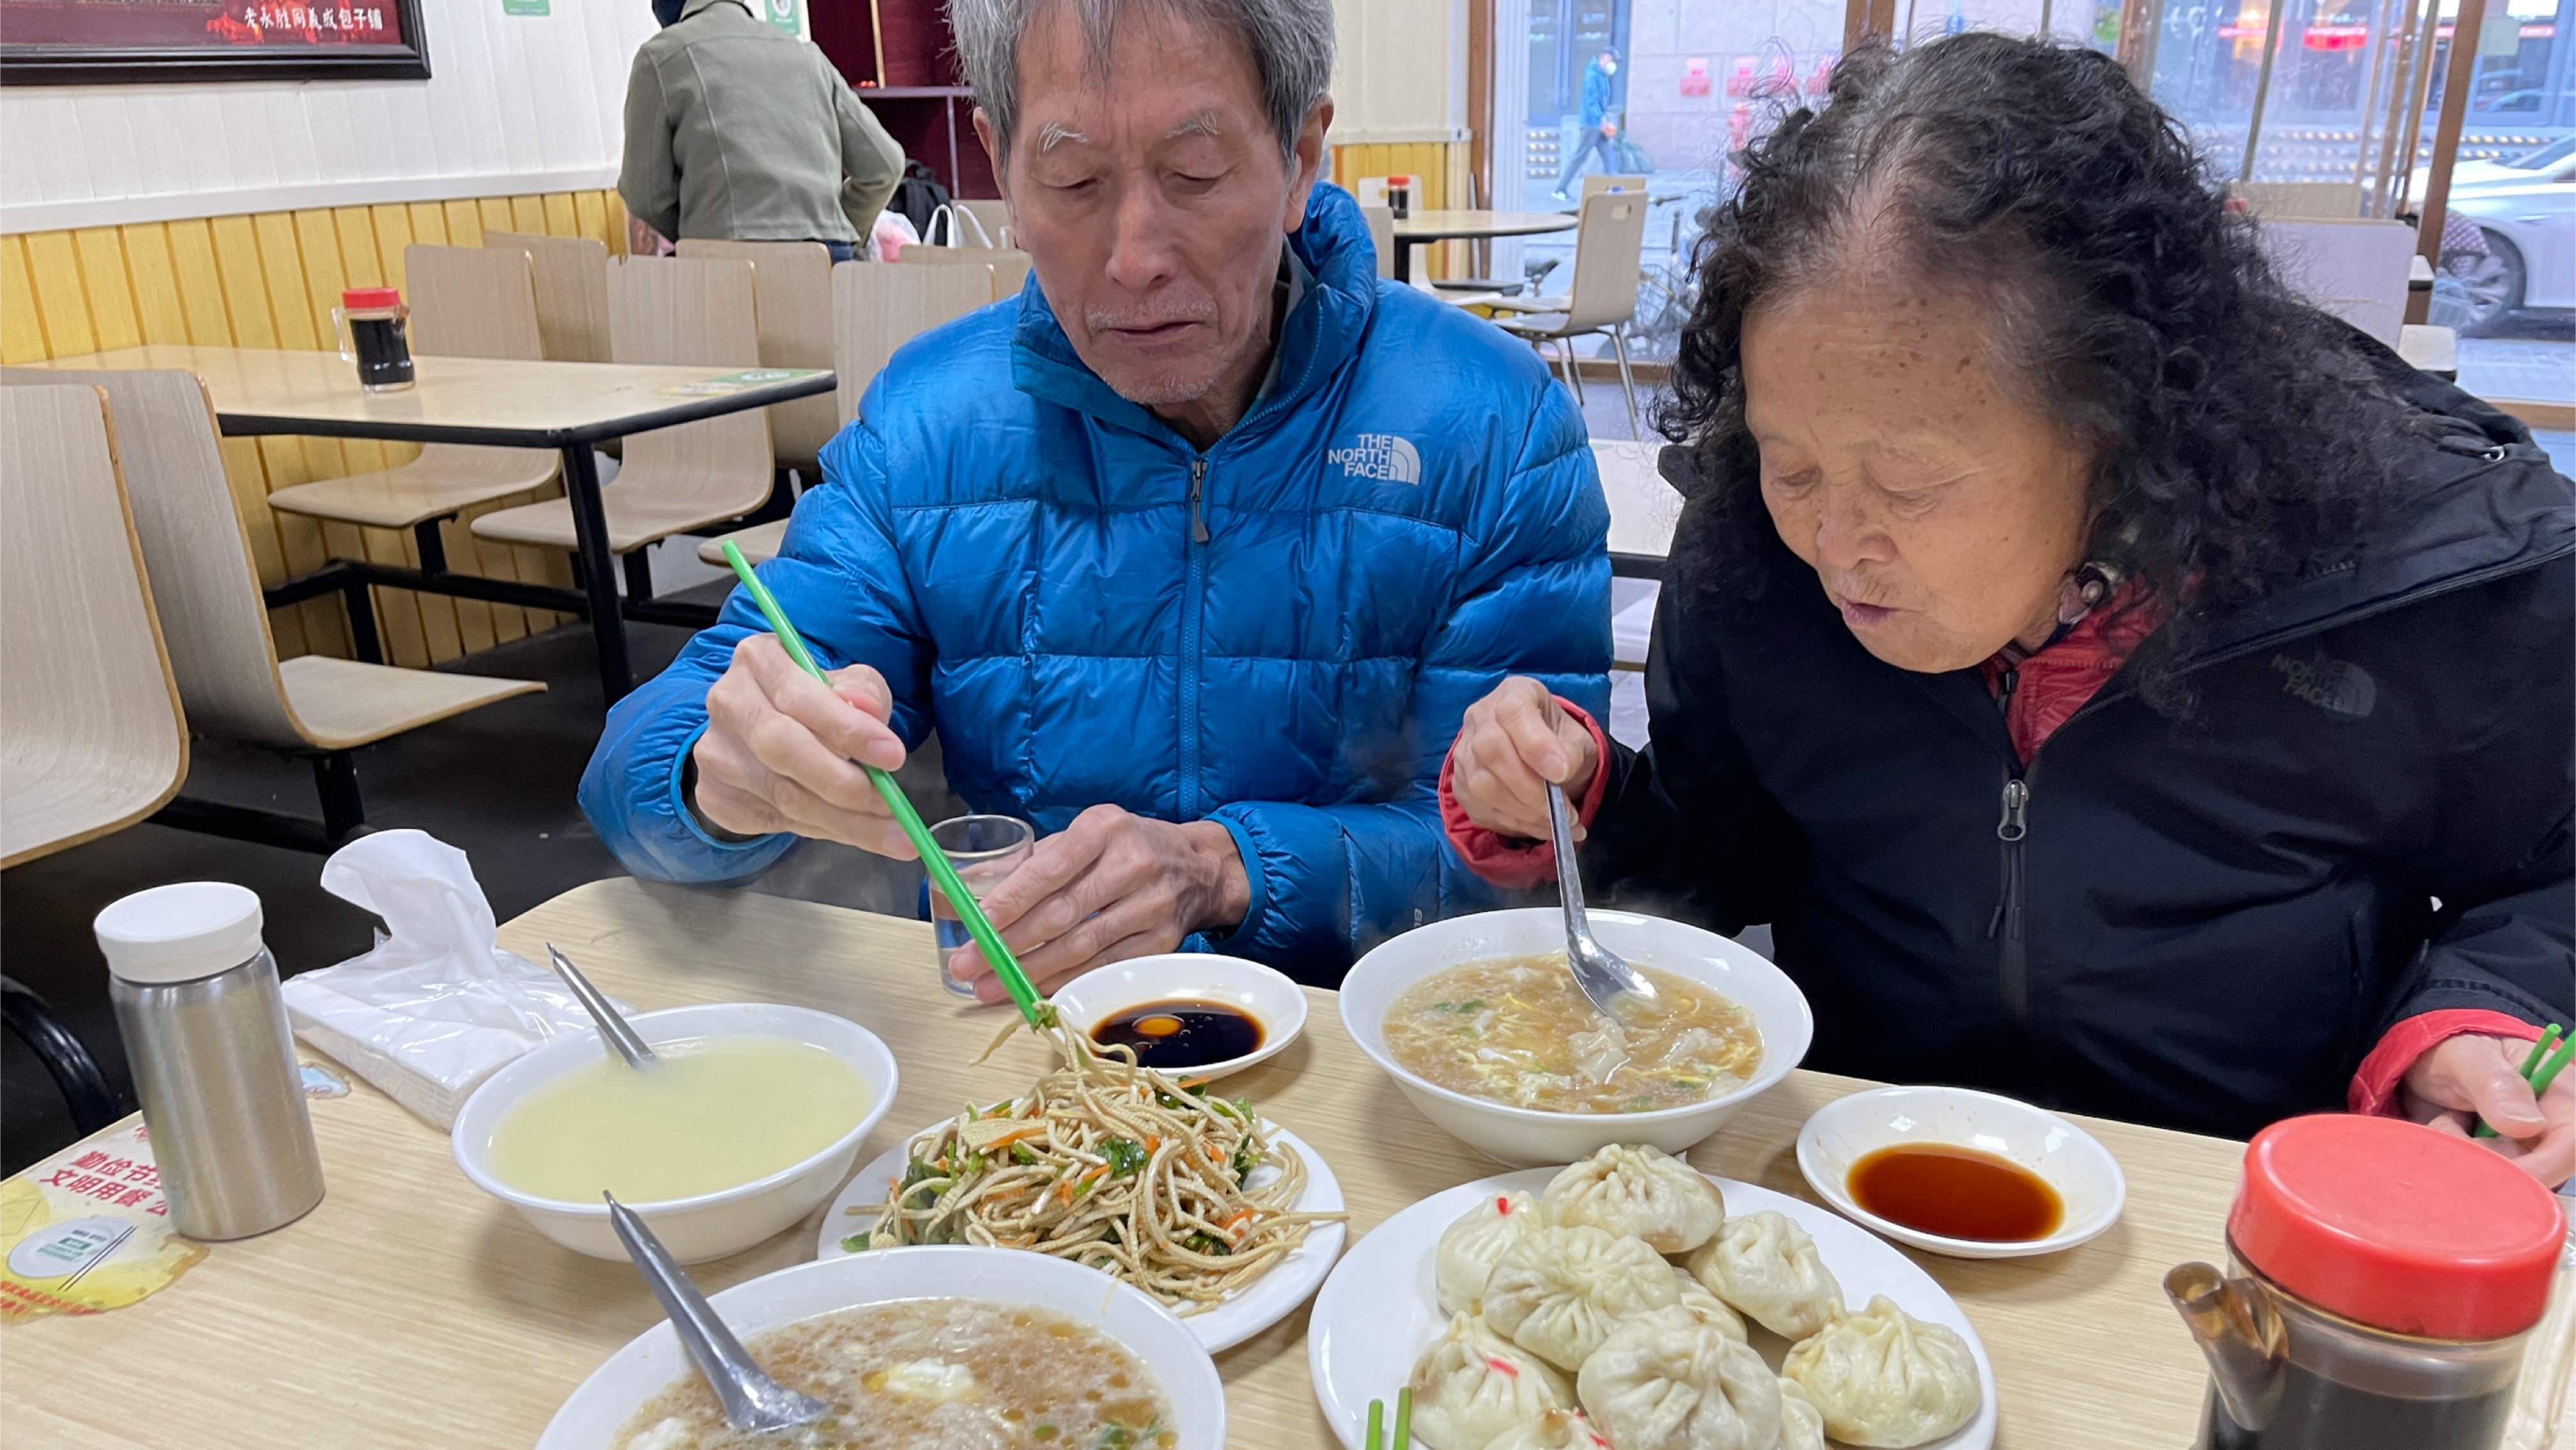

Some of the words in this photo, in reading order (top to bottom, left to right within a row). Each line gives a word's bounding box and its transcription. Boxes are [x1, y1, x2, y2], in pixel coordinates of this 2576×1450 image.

[1358, 434, 1392, 450] THE
[1328, 448, 1391, 465] NORTH
[1344, 462, 1389, 480] FACE
[2282, 677, 2334, 709] FACE
[39, 1169, 154, 1208] 文明用餐
